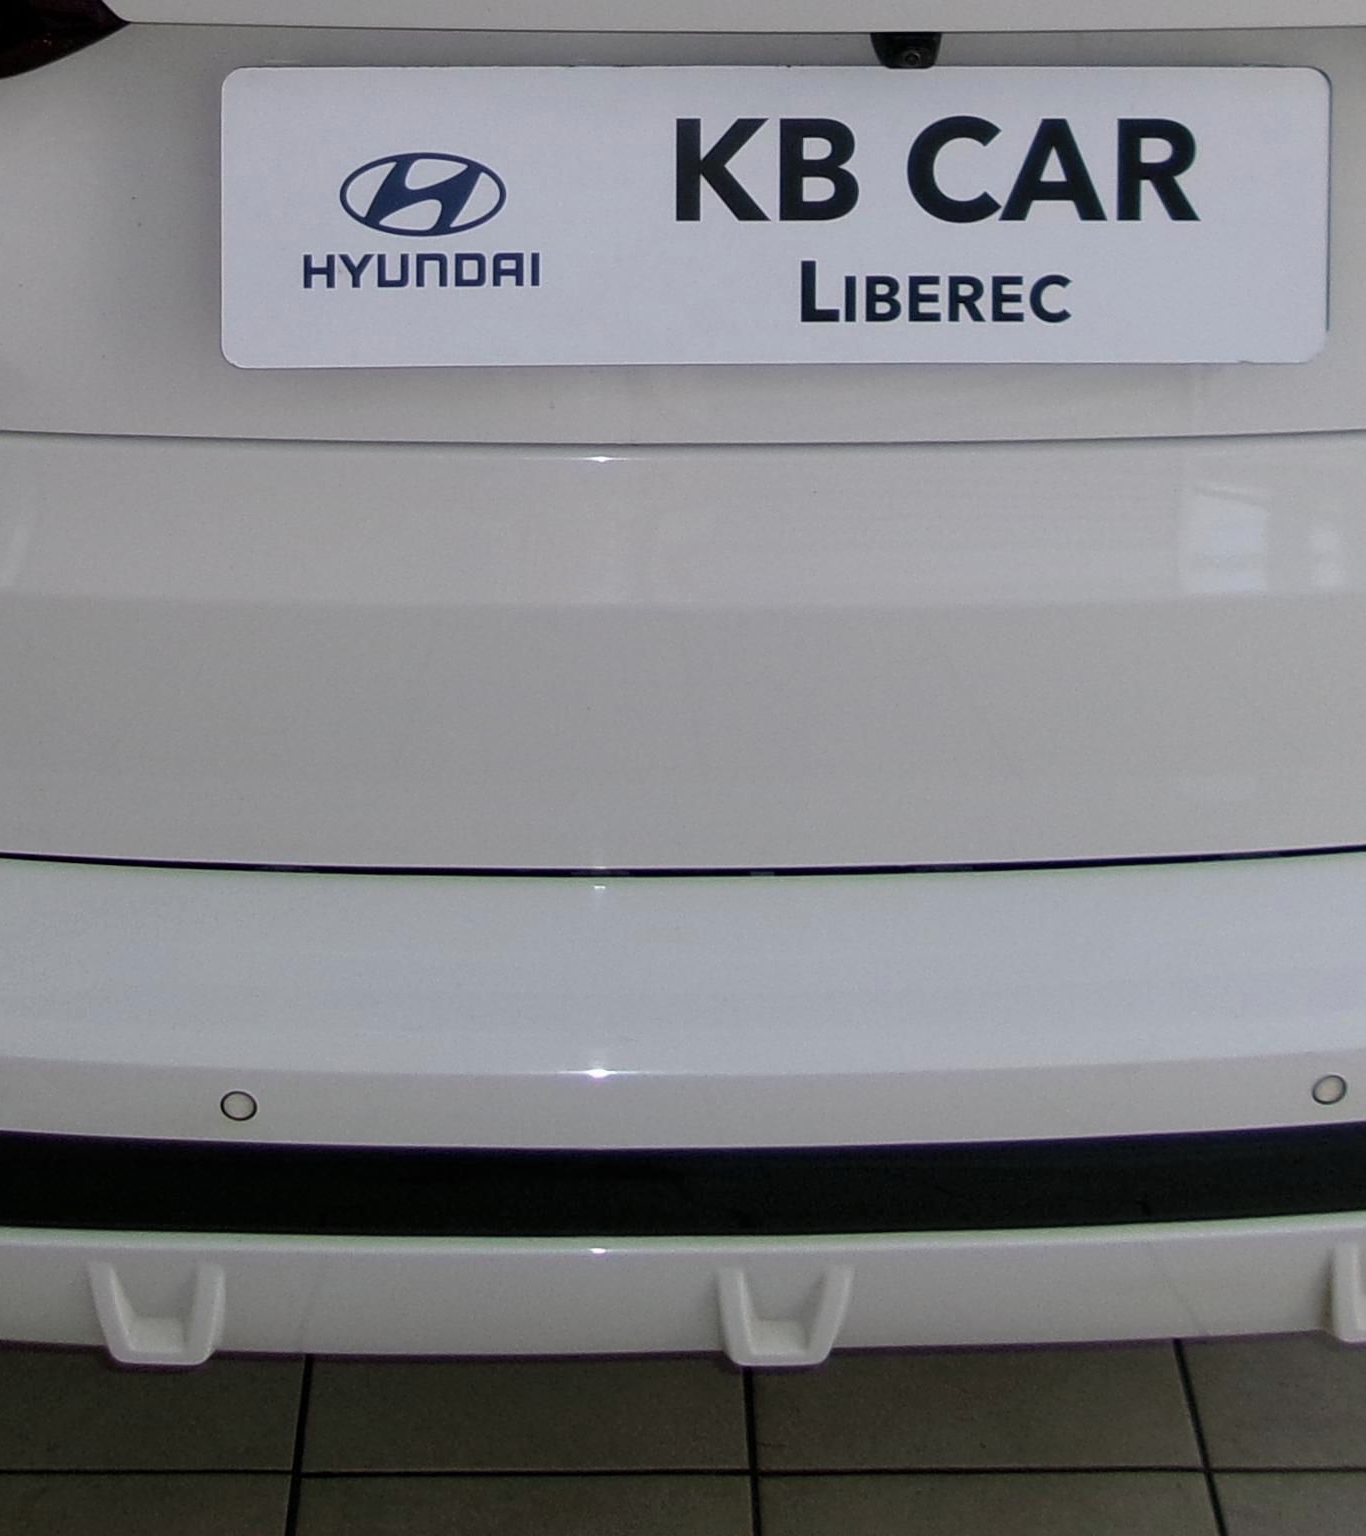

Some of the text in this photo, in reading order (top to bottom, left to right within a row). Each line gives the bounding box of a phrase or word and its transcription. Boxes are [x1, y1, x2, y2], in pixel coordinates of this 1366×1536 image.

[675, 115, 1201, 224] KB CAR
[303, 252, 541, 289] HYUNDAI
[800, 260, 1072, 324] LIBEREC
